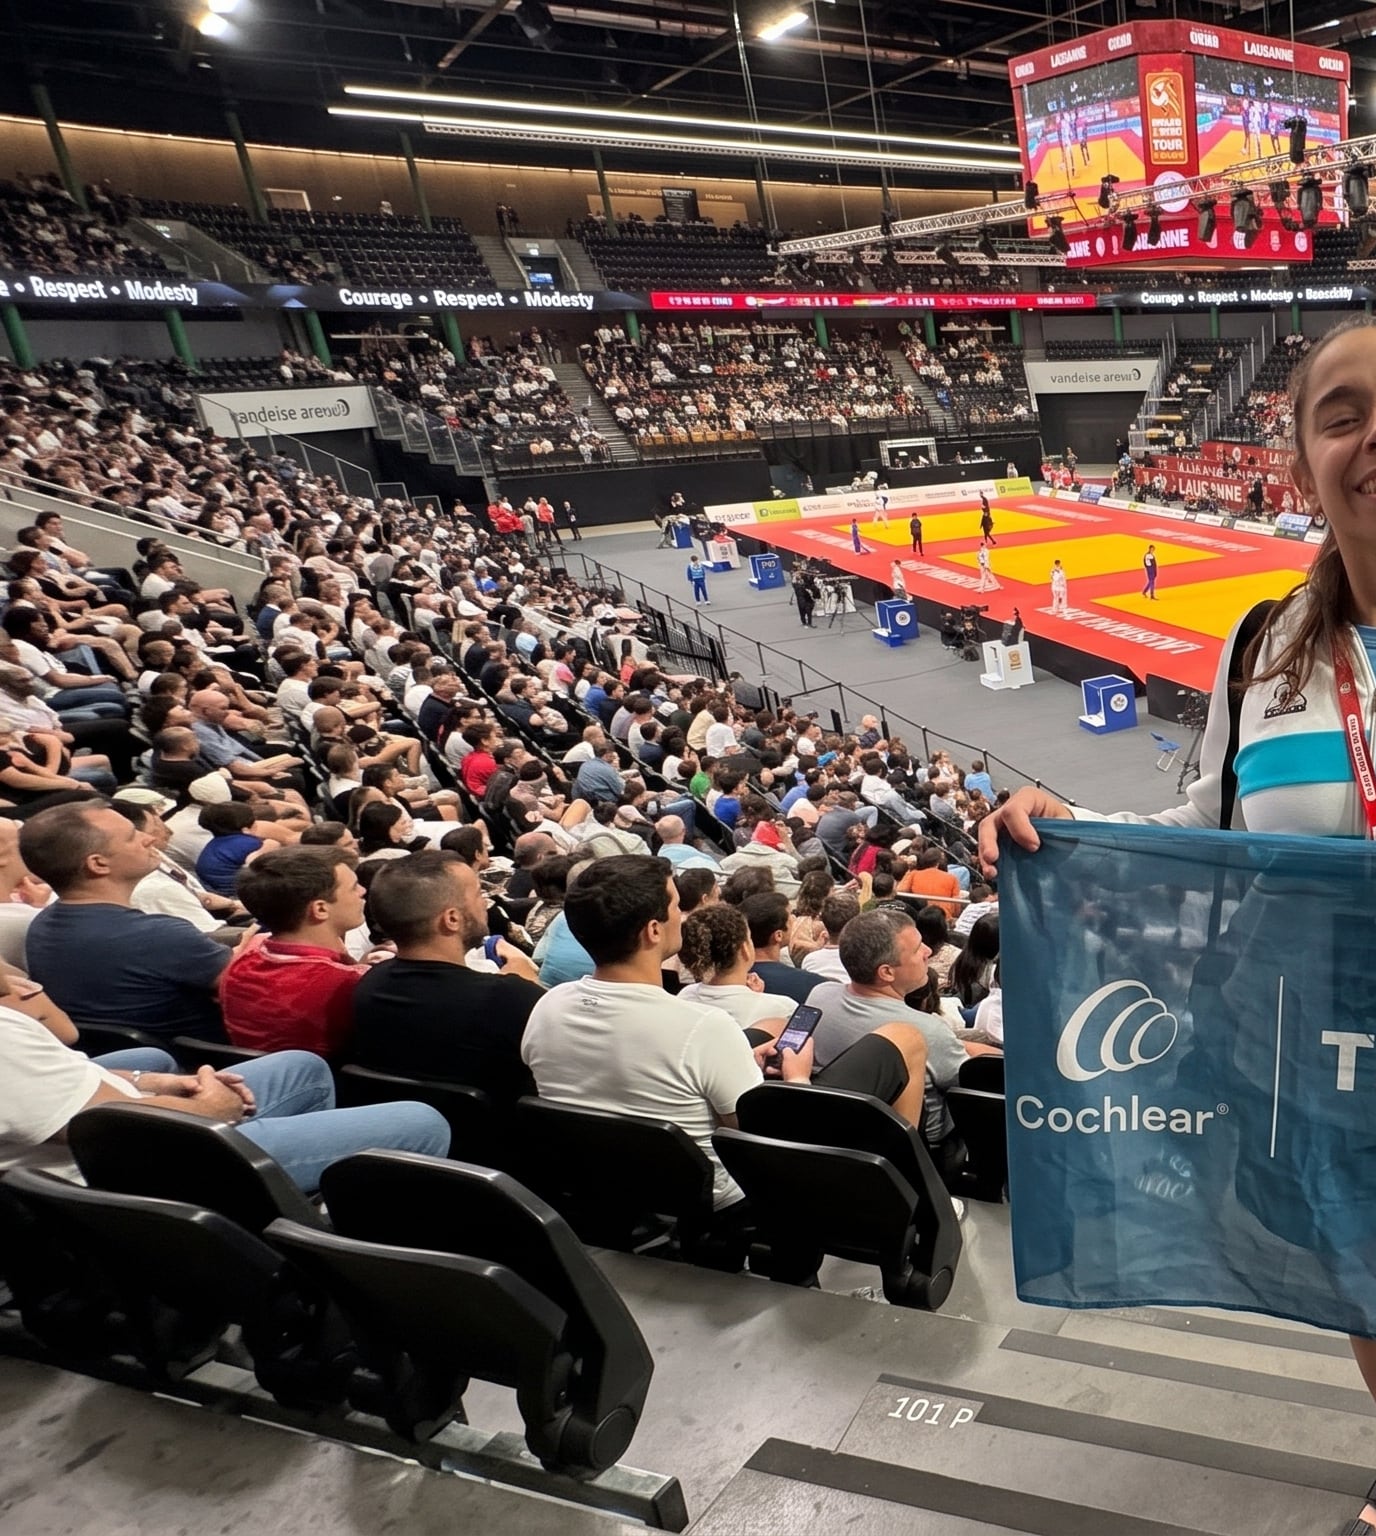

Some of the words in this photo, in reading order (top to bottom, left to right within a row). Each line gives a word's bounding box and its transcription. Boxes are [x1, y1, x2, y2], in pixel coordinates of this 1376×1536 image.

[1244, 41, 1294, 62] LAUSANNE
[1153, 139, 1183, 150] TOUR
[29, 275, 108, 303] Respect
[123, 279, 198, 306] Modesty
[338, 288, 414, 310] Courage
[432, 289, 505, 310] Respect
[523, 291, 594, 311] Modesty
[232, 406, 298, 424] andeise
[888, 1397, 945, 1425] 101
[949, 1408, 974, 1429] P
